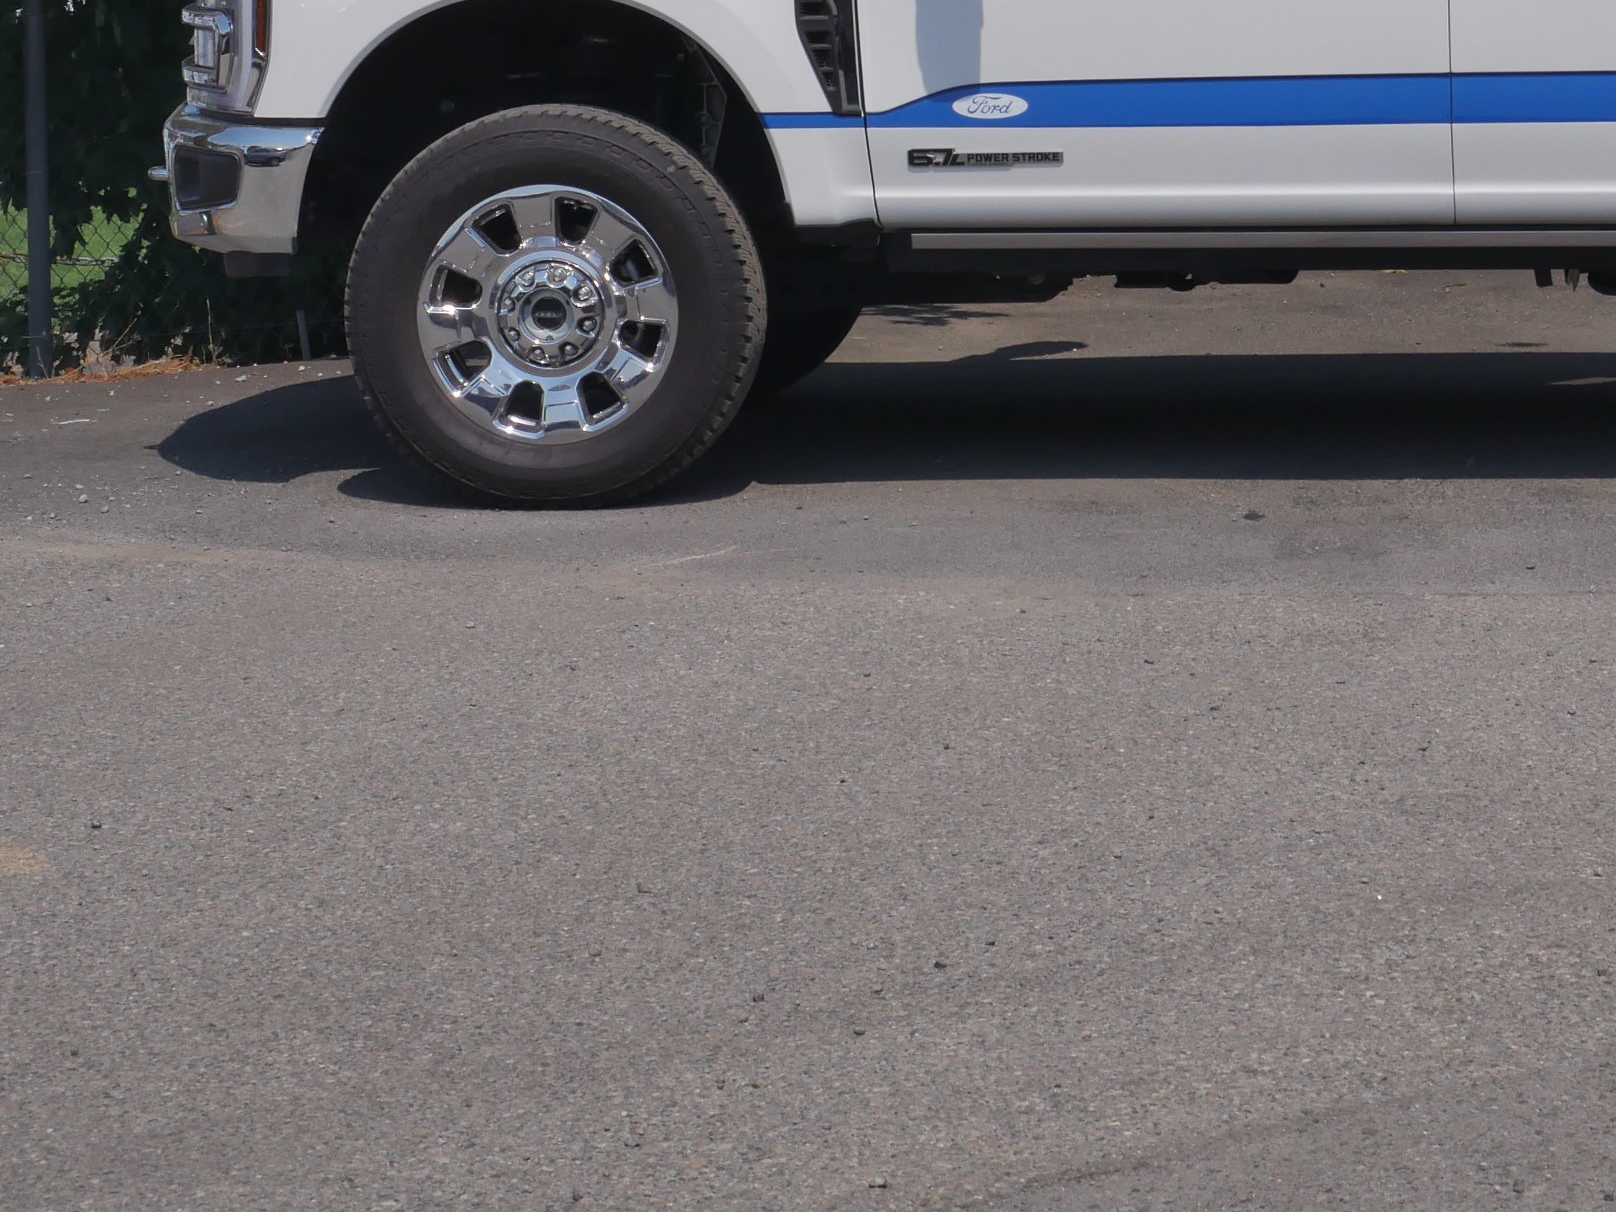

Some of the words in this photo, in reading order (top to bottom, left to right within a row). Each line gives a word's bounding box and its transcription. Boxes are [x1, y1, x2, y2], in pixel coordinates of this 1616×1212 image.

[967, 95, 1013, 114] Ford
[907, 148, 965, 166] 6.7L
[967, 152, 1009, 162] POWER
[1012, 151, 1060, 162] STROKE
